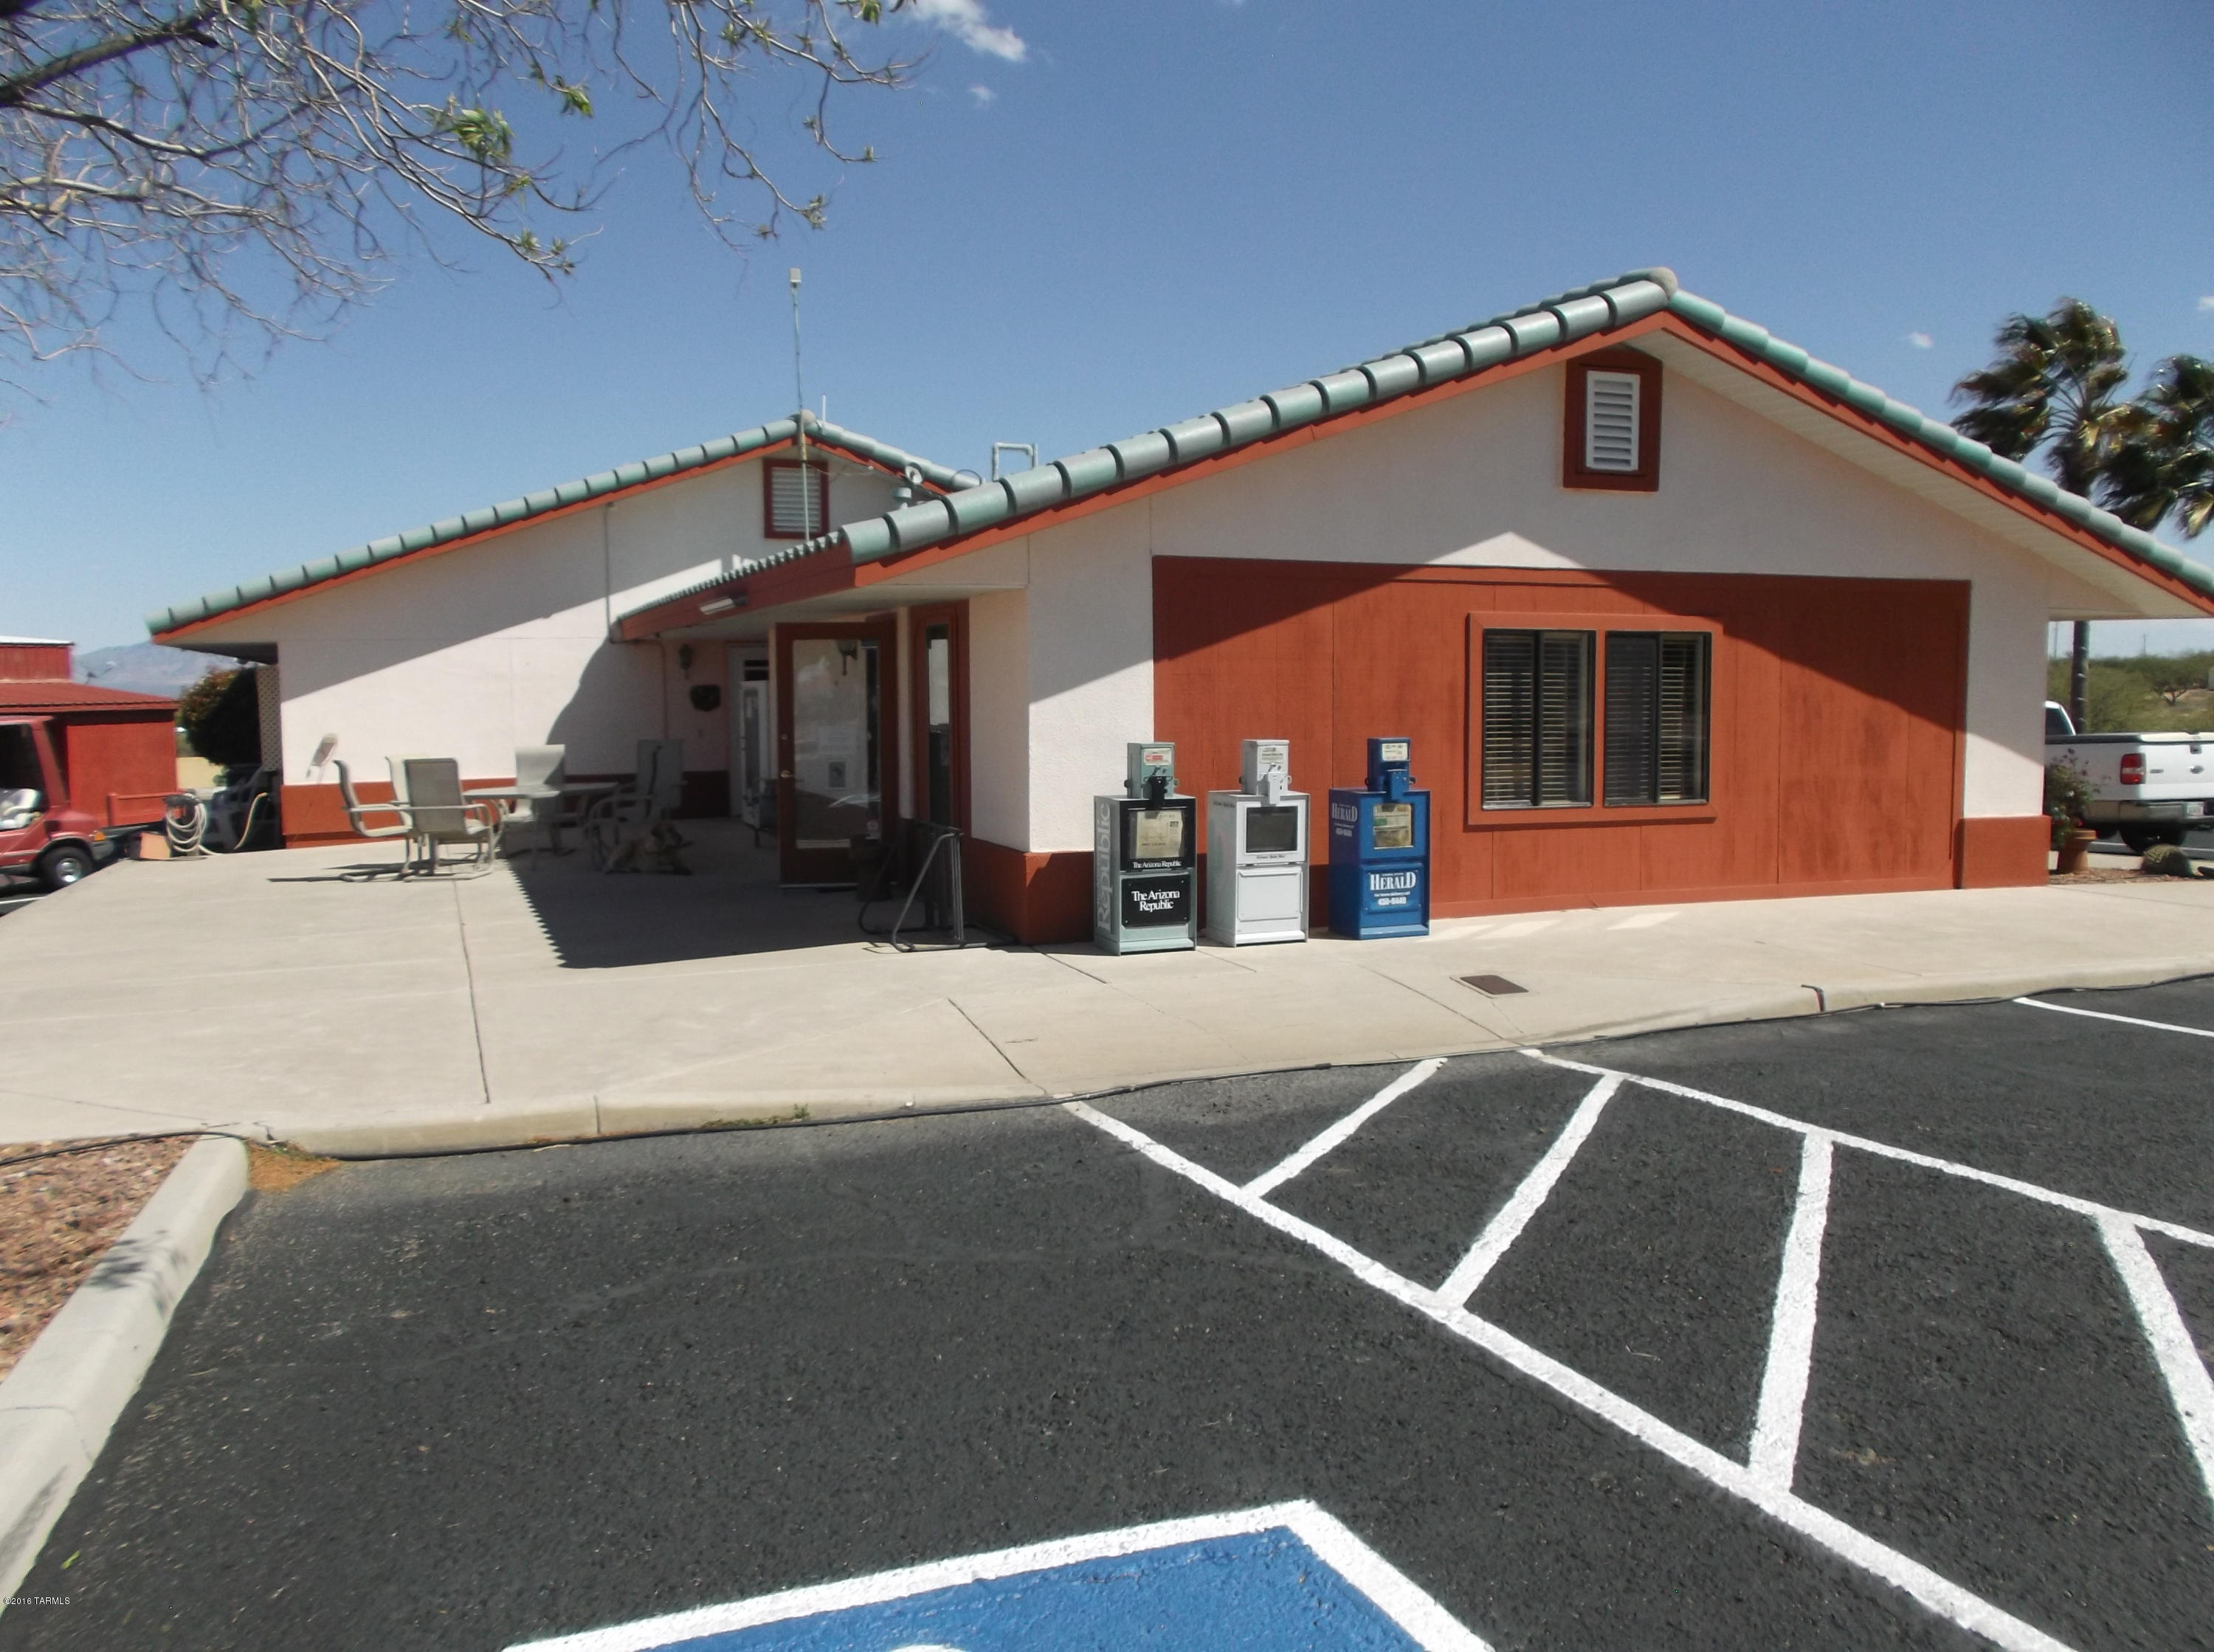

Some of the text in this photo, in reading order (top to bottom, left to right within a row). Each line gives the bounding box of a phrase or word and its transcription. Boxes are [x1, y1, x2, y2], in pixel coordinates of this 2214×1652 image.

[1332, 803, 1358, 822] HERALD
[1097, 802, 1113, 931] Republic
[1162, 860, 1182, 868] Republic
[1370, 871, 1416, 891] HERALD
[1131, 889, 1181, 901] The Arizona
[1139, 899, 1174, 913] Republic
